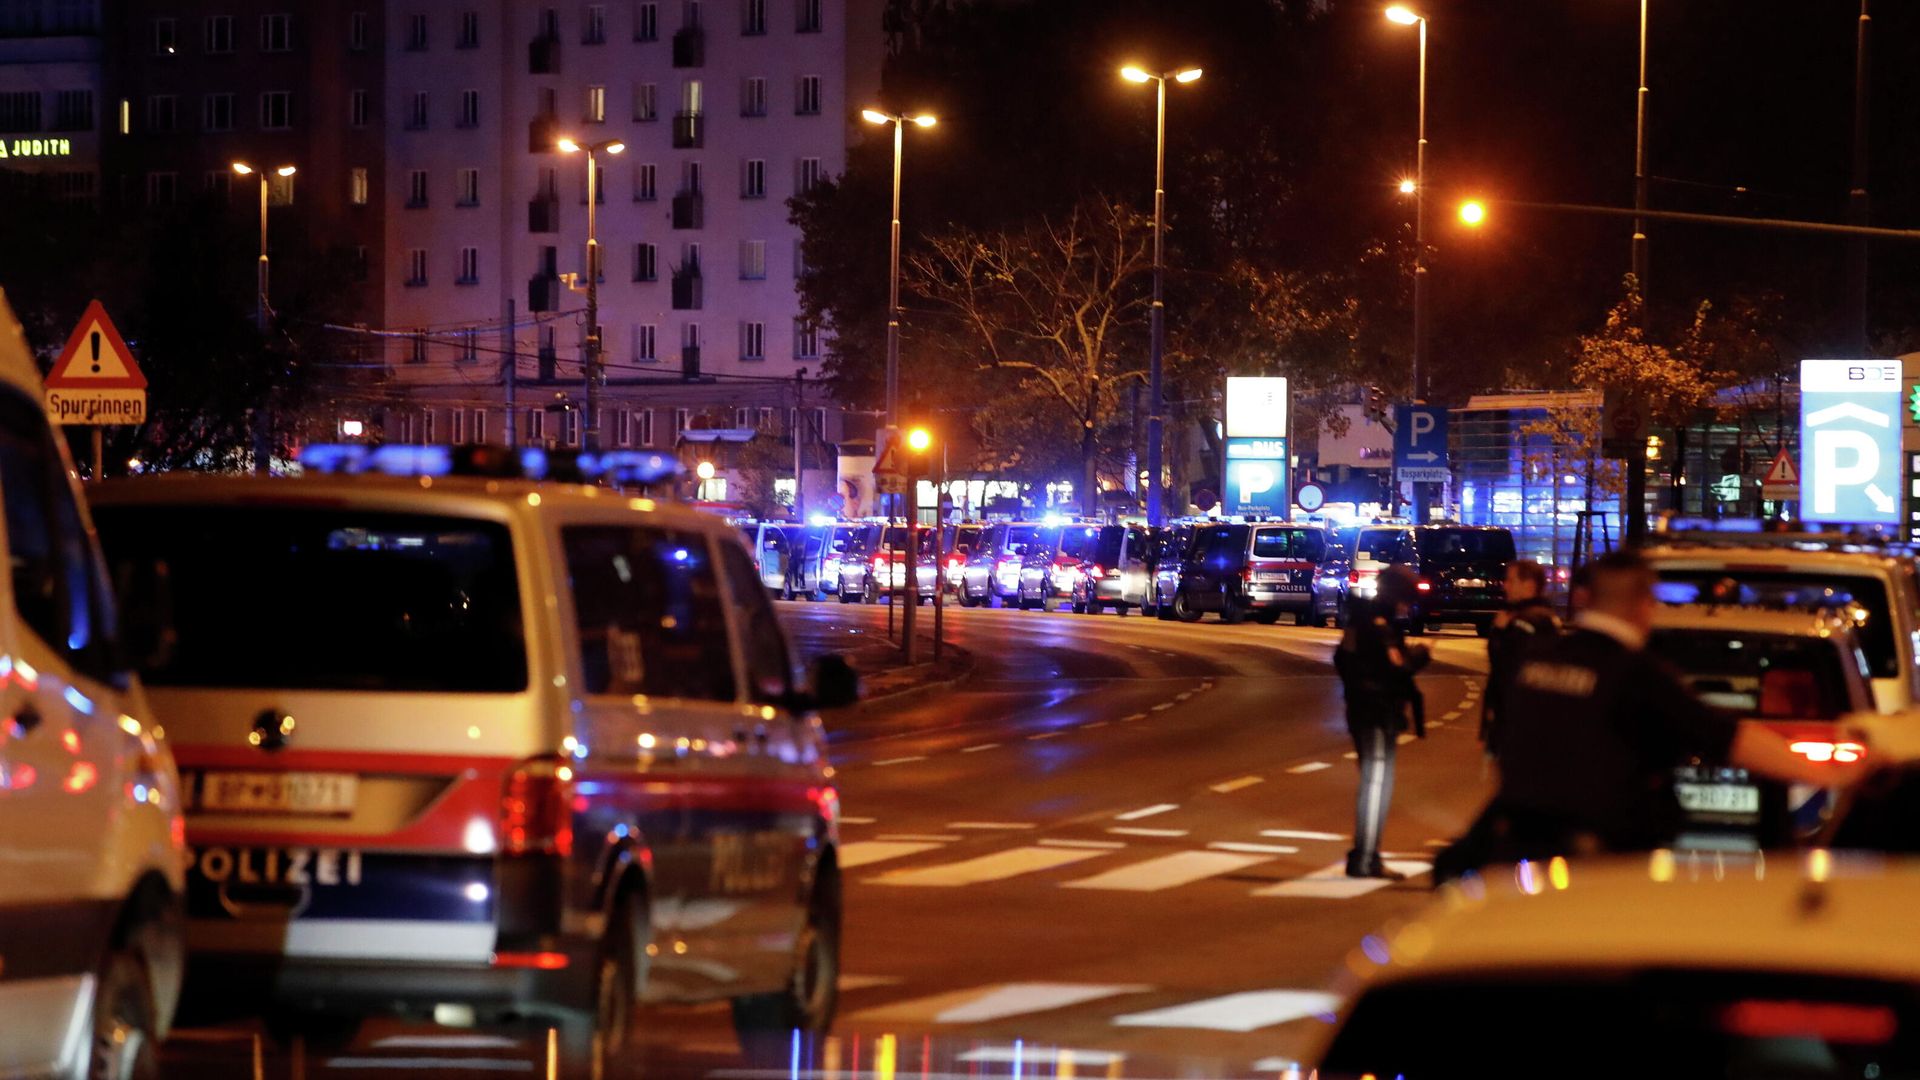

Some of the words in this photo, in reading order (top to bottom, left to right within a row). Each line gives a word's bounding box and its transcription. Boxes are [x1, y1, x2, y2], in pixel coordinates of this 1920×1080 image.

[12, 138, 70, 156] JUDITH
[50, 393, 142, 420] Spurrinnen
[1411, 412, 1436, 447] P
[1239, 462, 1275, 504] P
[1814, 430, 1880, 513] P
[1275, 584, 1307, 592] POLIZEI
